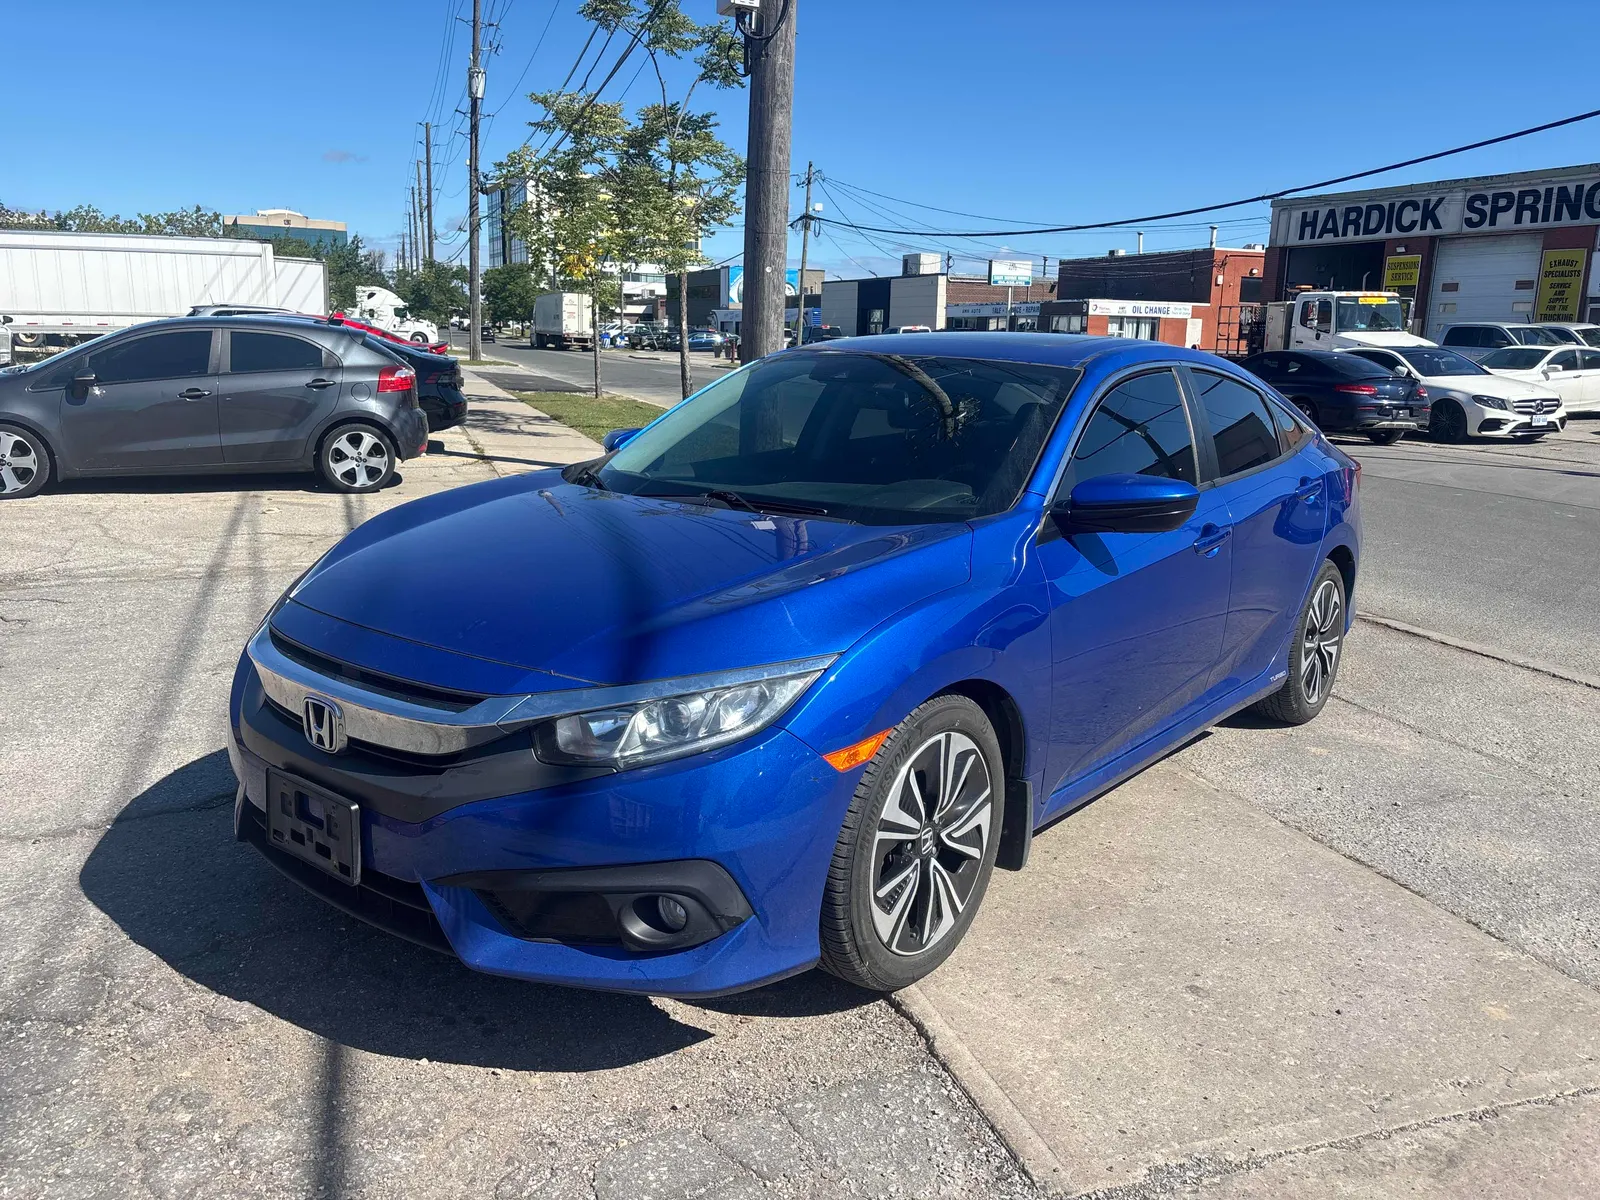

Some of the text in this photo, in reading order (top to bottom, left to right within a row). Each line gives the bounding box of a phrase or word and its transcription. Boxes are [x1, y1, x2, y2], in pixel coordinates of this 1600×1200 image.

[1298, 181, 1600, 241] HARDICK SPRING
[1549, 259, 1578, 268] EXHAUST
[1391, 272, 1413, 281] SERVICE
[1544, 270, 1581, 278] SPECIALISTS
[1132, 305, 1142, 314] OIL
[1144, 306, 1170, 315] CHANGE
[1269, 670, 1286, 681] TURBO
